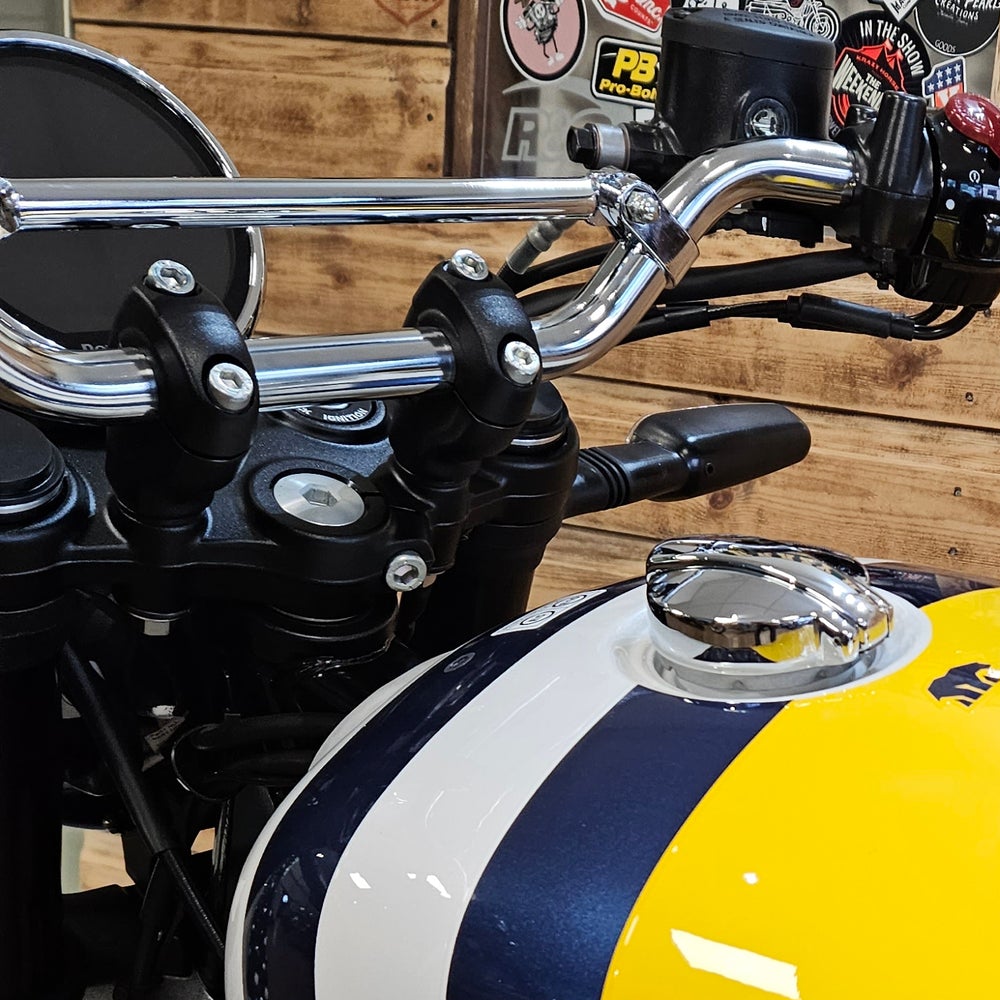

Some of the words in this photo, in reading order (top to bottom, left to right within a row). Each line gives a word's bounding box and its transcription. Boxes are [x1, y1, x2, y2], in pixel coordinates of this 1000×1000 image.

[859, 19, 873, 38] IN
[877, 19, 900, 43] THE
[897, 33, 925, 77] SHOW
[934, 39, 956, 54] GOODS
[612, 47, 658, 83] PB
[599, 78, 657, 100] Pro-Bol
[865, 72, 882, 89] THE
[322, 407, 369, 423] IGNITION
